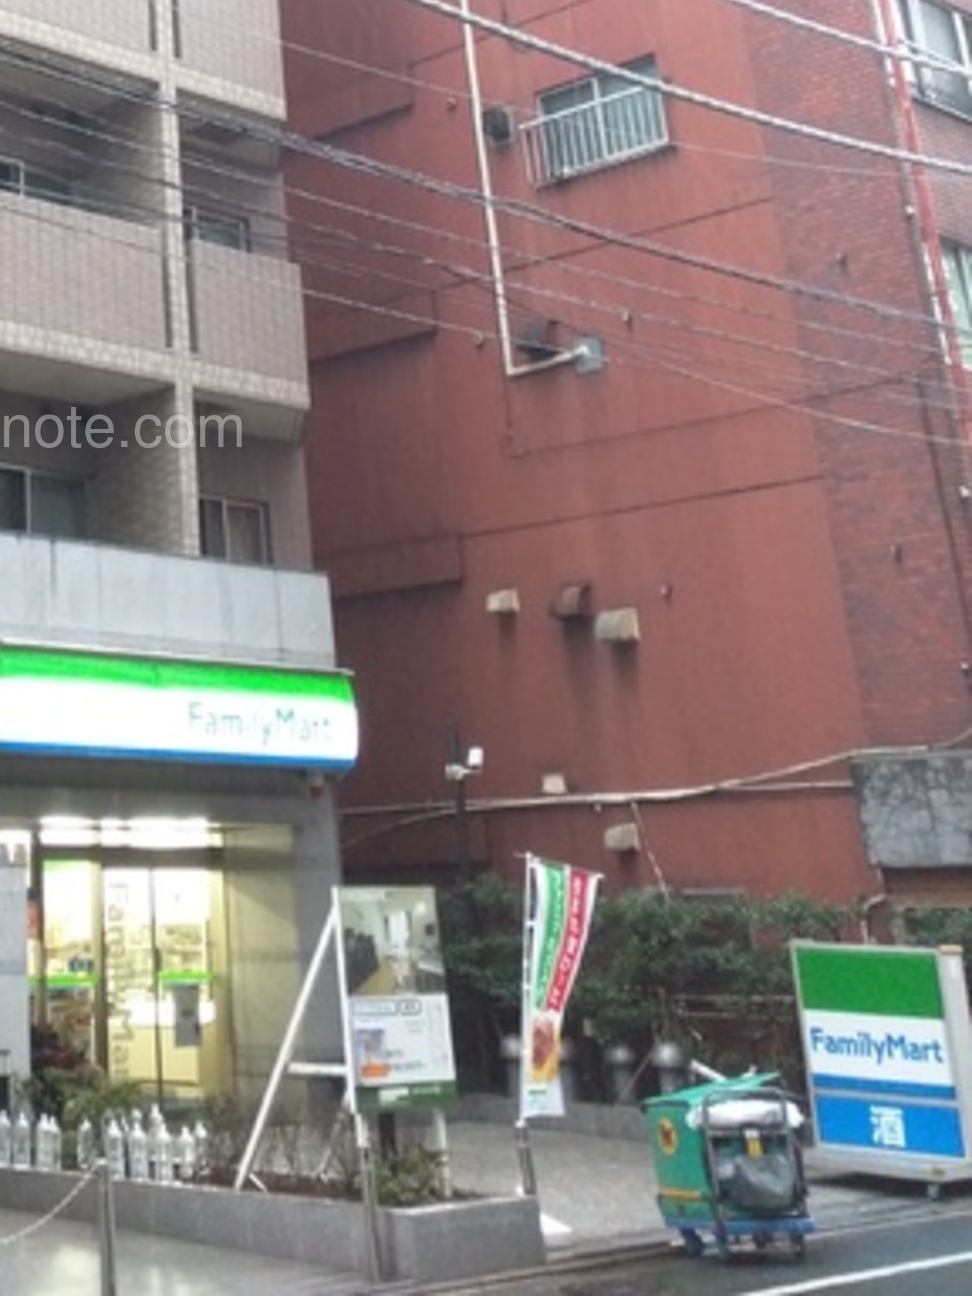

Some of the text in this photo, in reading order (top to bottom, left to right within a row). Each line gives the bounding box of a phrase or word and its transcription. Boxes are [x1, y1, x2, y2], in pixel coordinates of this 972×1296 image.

[187, 701, 331, 747] FamilyMart
[808, 1026, 945, 1064] FamilyMart
[869, 1105, 907, 1148] 酒
